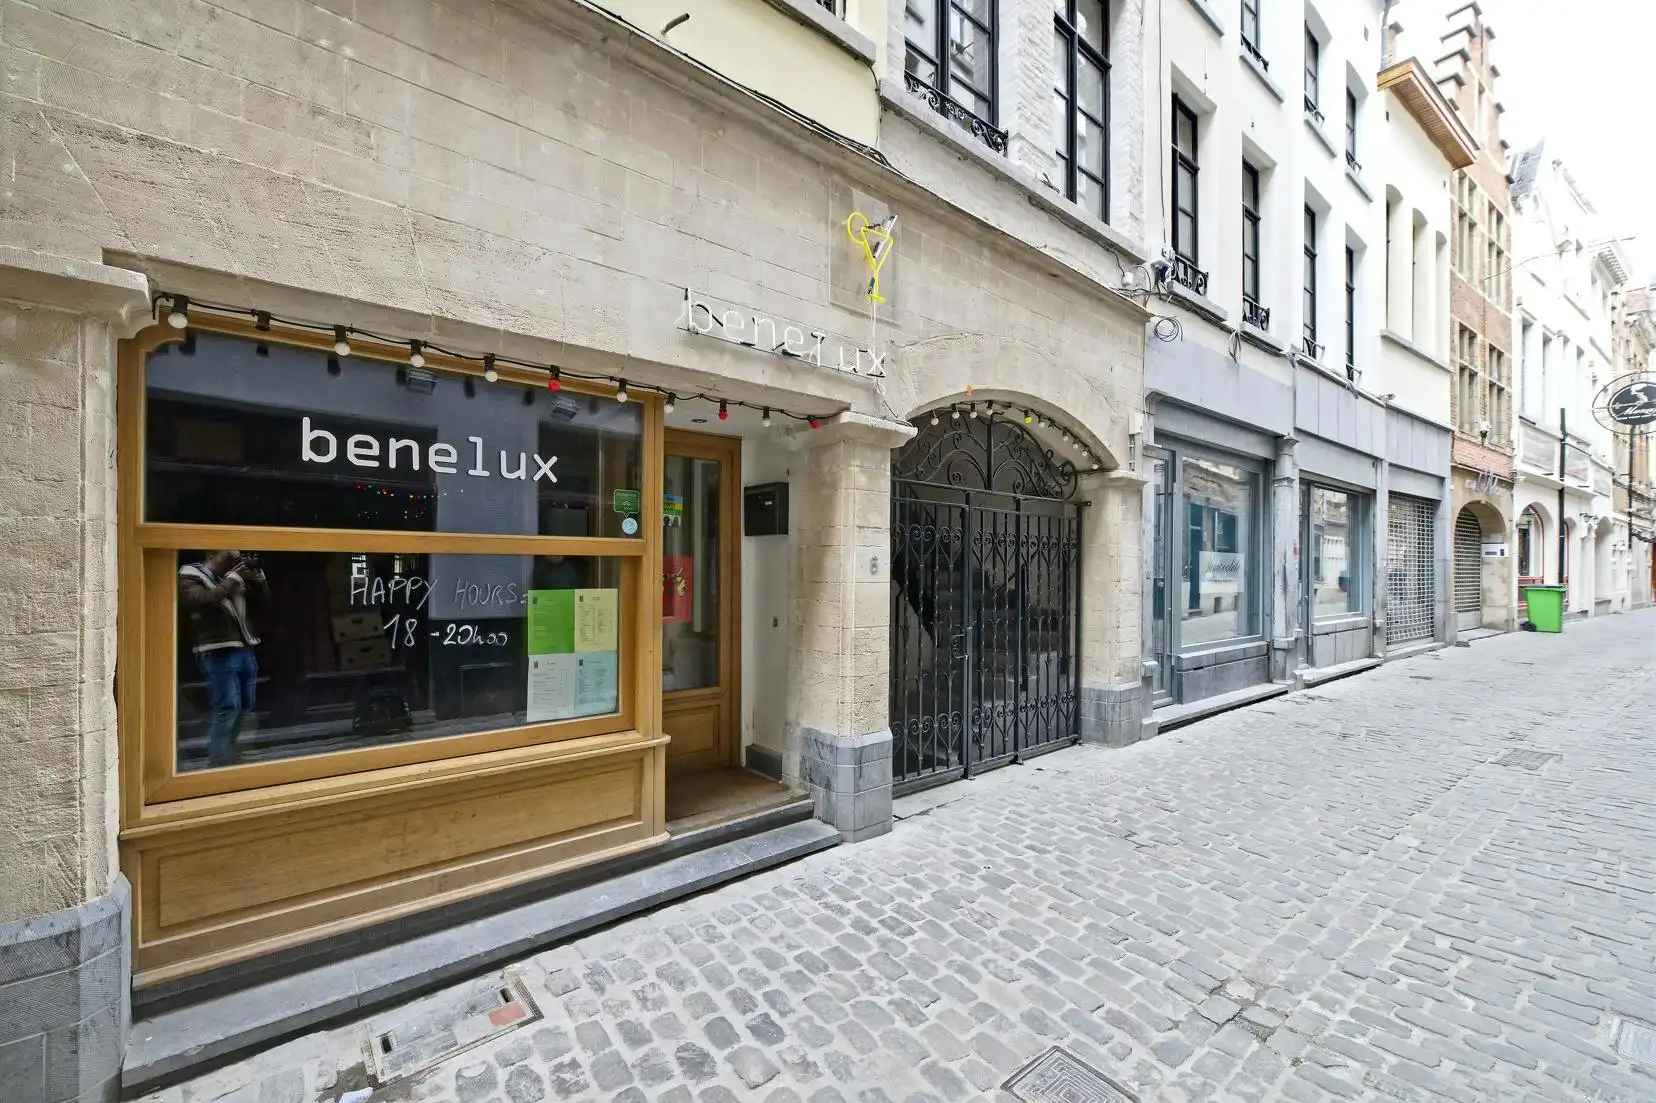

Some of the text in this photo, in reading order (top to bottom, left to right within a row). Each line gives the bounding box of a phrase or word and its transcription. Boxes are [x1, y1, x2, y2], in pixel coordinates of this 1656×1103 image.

[686, 286, 887, 378] benelux
[301, 416, 558, 483] benelux
[350, 576, 438, 610] HAPPY
[383, 614, 417, 649] 18
